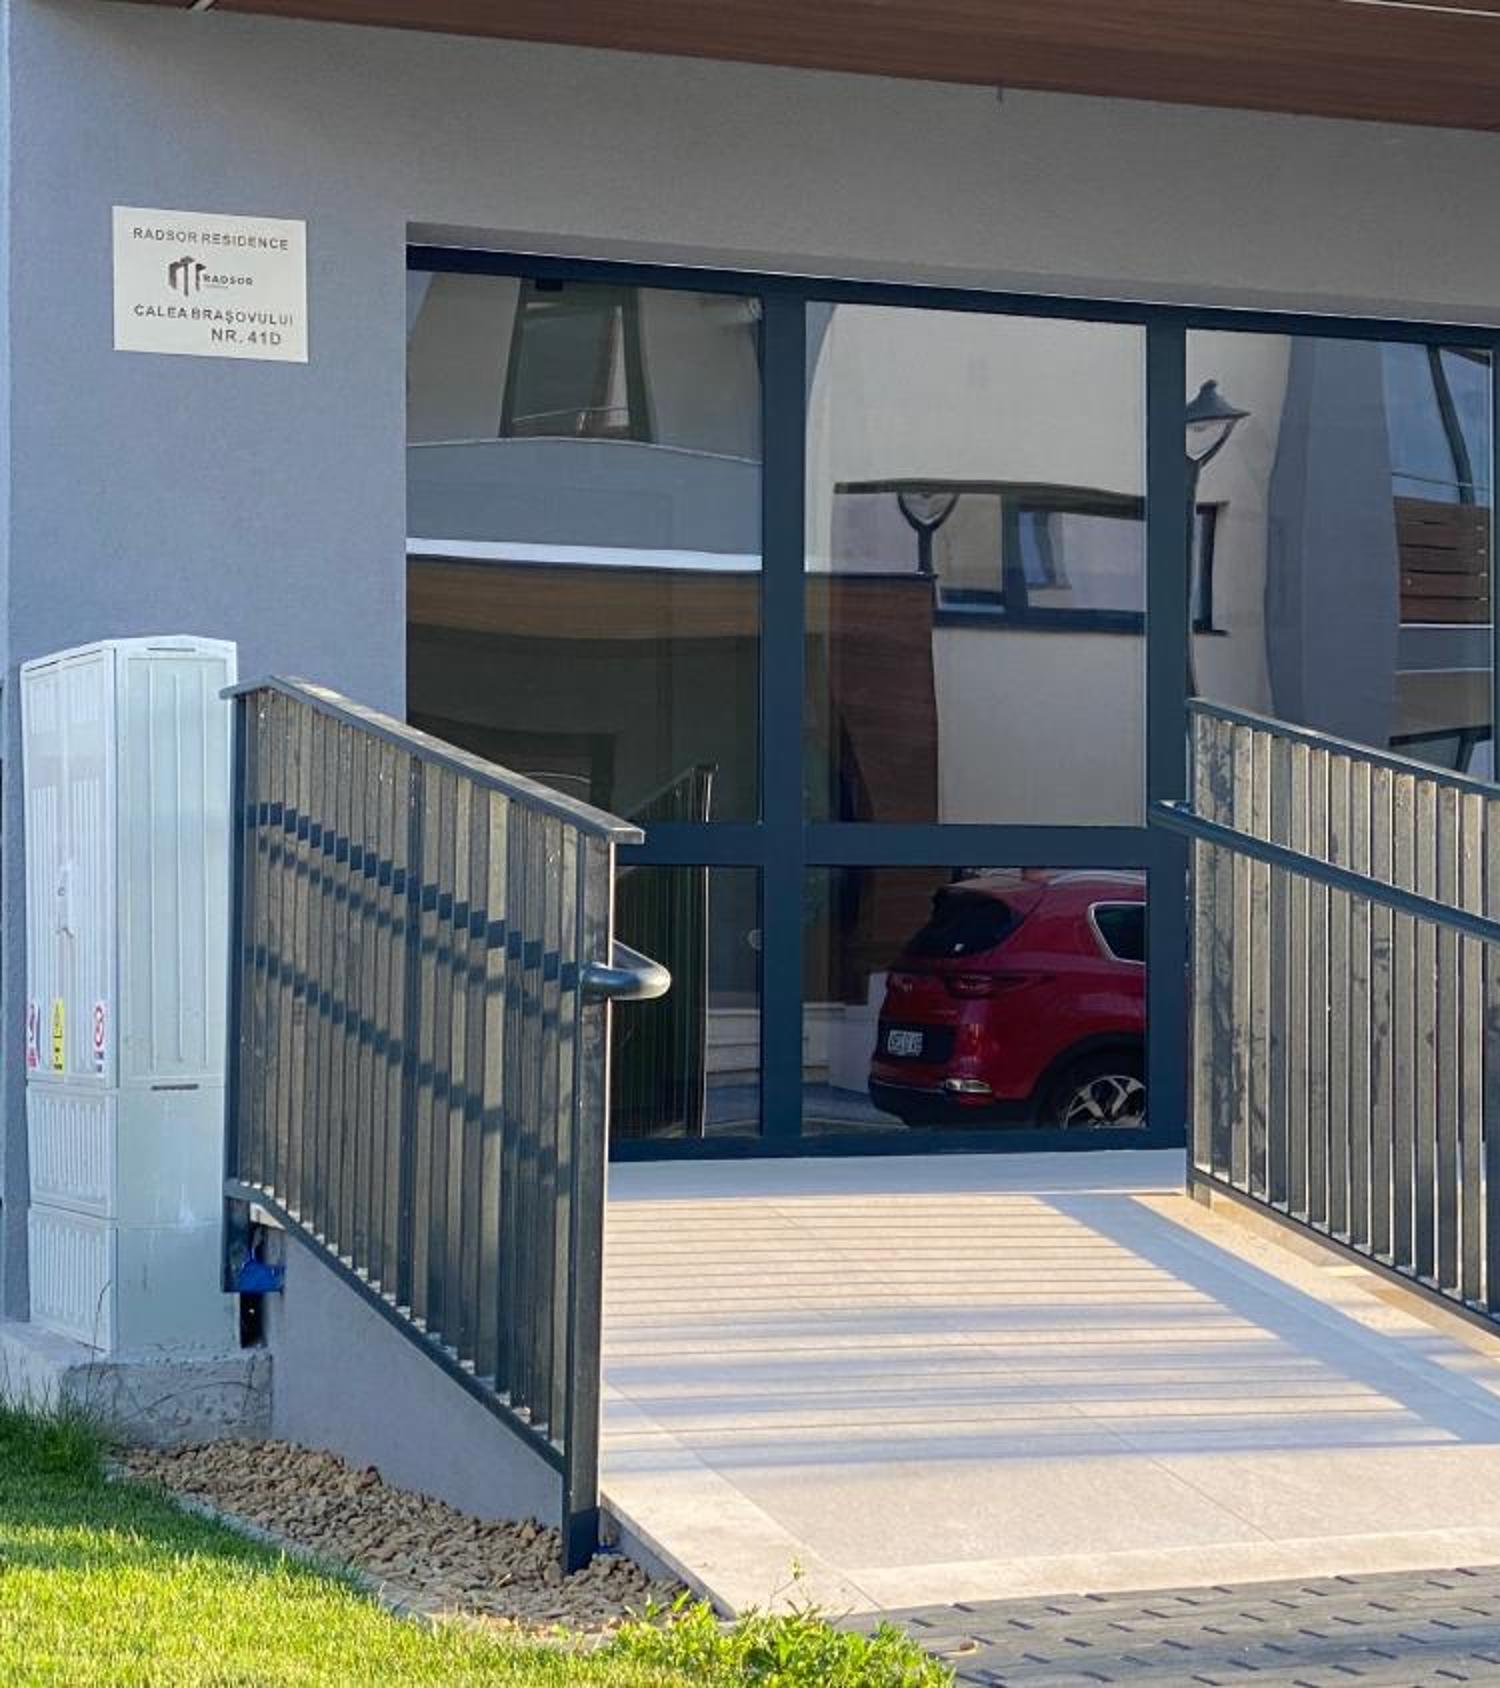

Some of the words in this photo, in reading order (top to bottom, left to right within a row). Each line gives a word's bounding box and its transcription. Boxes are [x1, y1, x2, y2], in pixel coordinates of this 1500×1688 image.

[133, 227, 197, 244] RADSOR
[201, 233, 289, 251] RESIDENCE
[134, 304, 188, 320] CALEA
[211, 328, 244, 344] NR.
[247, 330, 282, 346] 41D
